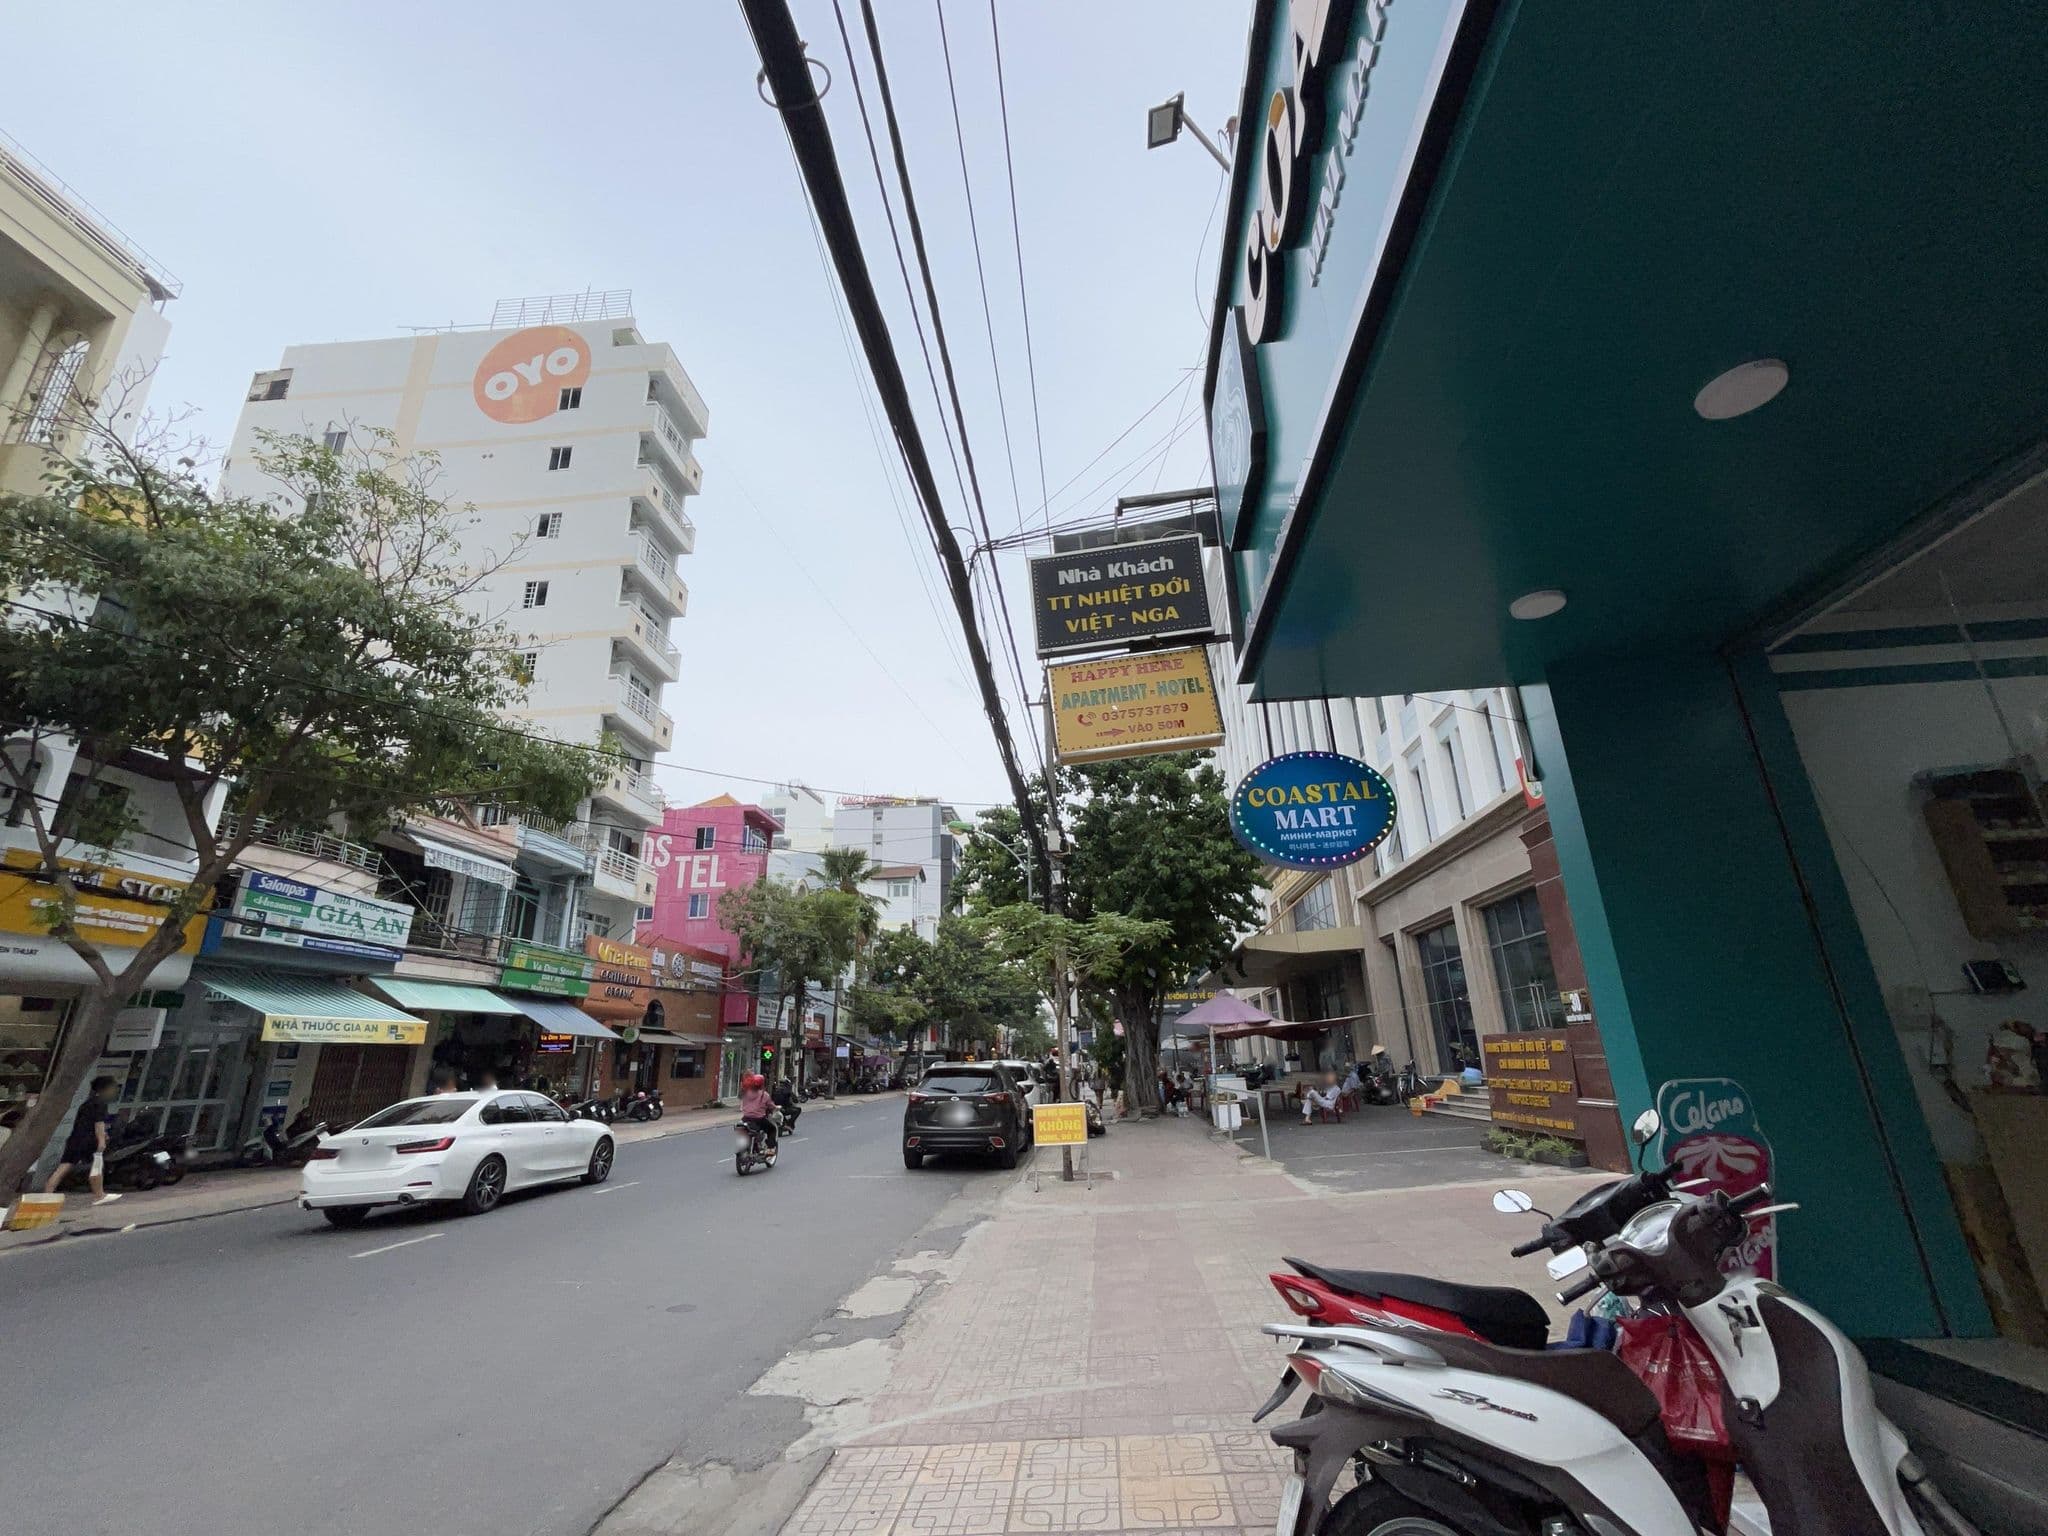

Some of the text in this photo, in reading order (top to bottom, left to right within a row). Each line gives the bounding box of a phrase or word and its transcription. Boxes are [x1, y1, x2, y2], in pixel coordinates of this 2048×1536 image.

[485, 347, 580, 401] OYO
[1058, 556, 1174, 585] Nhà Khách
[1047, 595, 1072, 611] TT
[1078, 583, 1144, 606] NHIỆT
[1065, 612, 1115, 634] VIỆT
[1132, 606, 1180, 625] NGA
[1071, 658, 1185, 683] HAPPY HERE
[1061, 683, 1147, 710] APARTMENT
[1157, 677, 1205, 697] HOTEL
[1102, 702, 1189, 722] 0375737879
[1158, 719, 1185, 730] 50M
[1248, 780, 1378, 808] COASTAL
[1274, 806, 1356, 830] MART
[1281, 828, 1358, 841] мини-маркет
[675, 855, 726, 888] TEL
[259, 876, 308, 897] Salonpas
[316, 904, 363, 930] GIA
[371, 916, 406, 936] AN
[271, 1018, 298, 1031] NHÀ
[343, 1023, 361, 1032] GIA
[364, 1024, 378, 1032] AN
